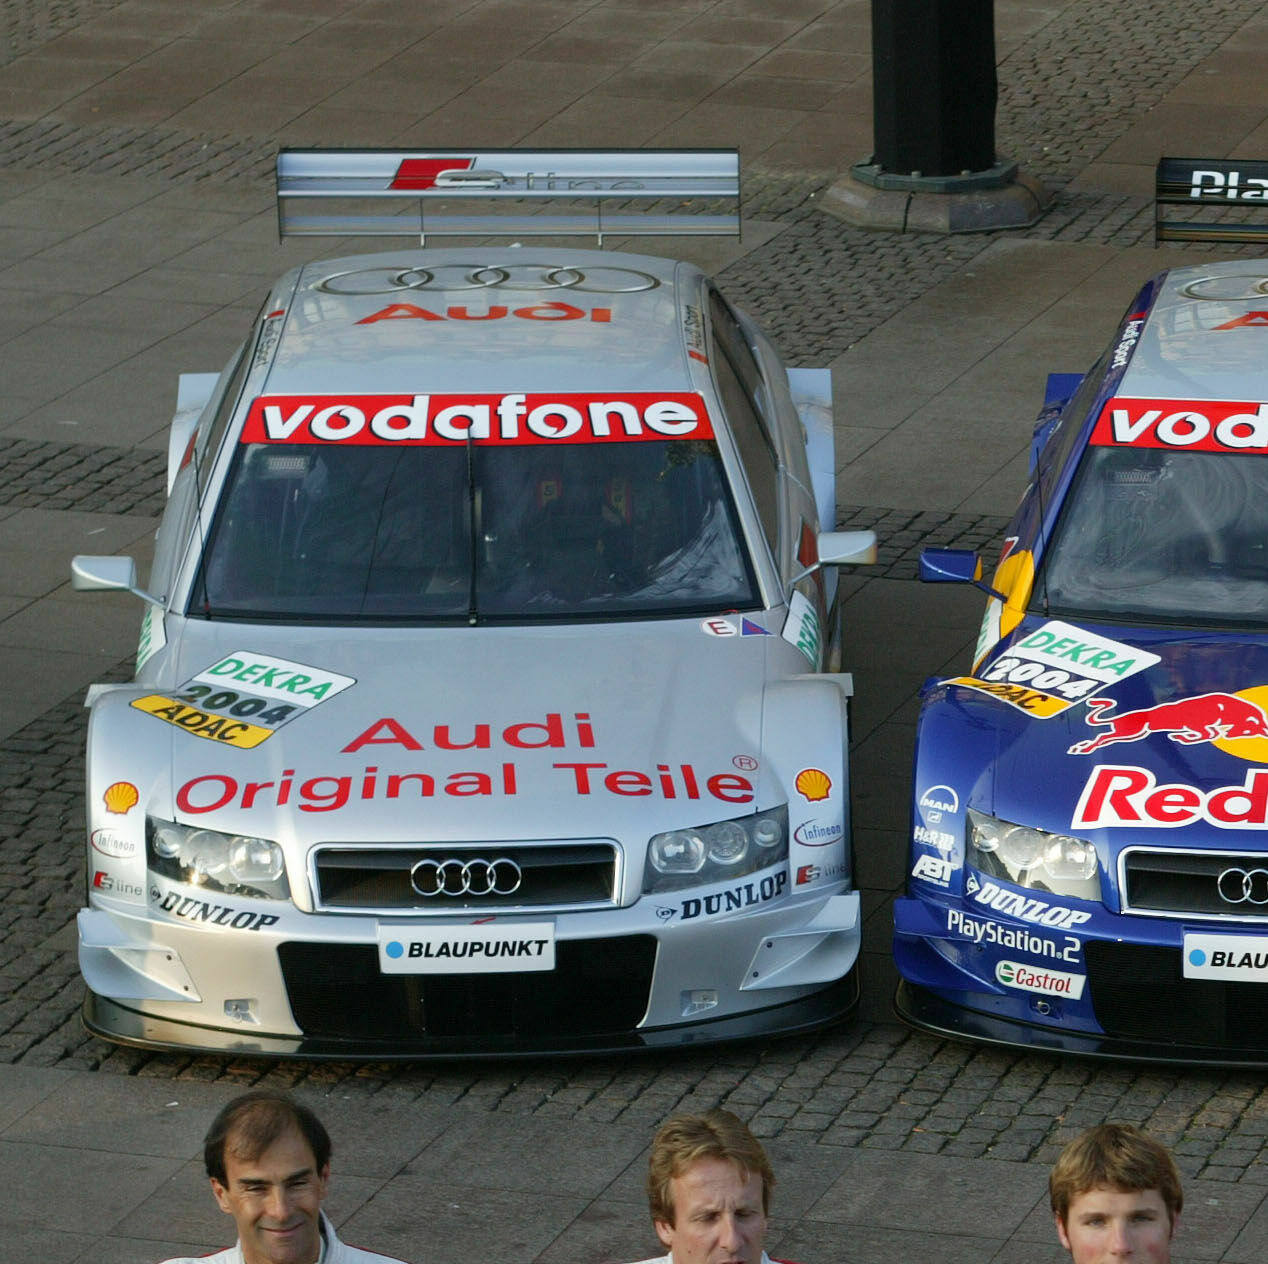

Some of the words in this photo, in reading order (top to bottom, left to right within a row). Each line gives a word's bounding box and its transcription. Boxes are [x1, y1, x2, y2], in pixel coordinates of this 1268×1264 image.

[353, 301, 612, 325] Audi
[264, 393, 698, 441] vodafone
[1018, 630, 1137, 677] DEKRA
[207, 658, 334, 701] DEKRA
[984, 657, 1099, 699] 2004
[151, 700, 250, 741] ADAC
[184, 685, 298, 725] 2004
[339, 712, 596, 753] Audi
[175, 762, 518, 816] Original
[552, 762, 756, 804] Teile
[921, 797, 957, 813] MAN
[98, 833, 135, 853] Infineon
[803, 822, 842, 841] Infineon
[159, 891, 281, 932] DUNLOP
[680, 869, 788, 921] DUNLOP
[974, 882, 1092, 929] DUNLOP
[407, 939, 549, 958] BLAUPUNKT
[947, 909, 1057, 959] PlayStation
[1062, 936, 1081, 964] 2
[1015, 968, 1072, 994] Castrol
